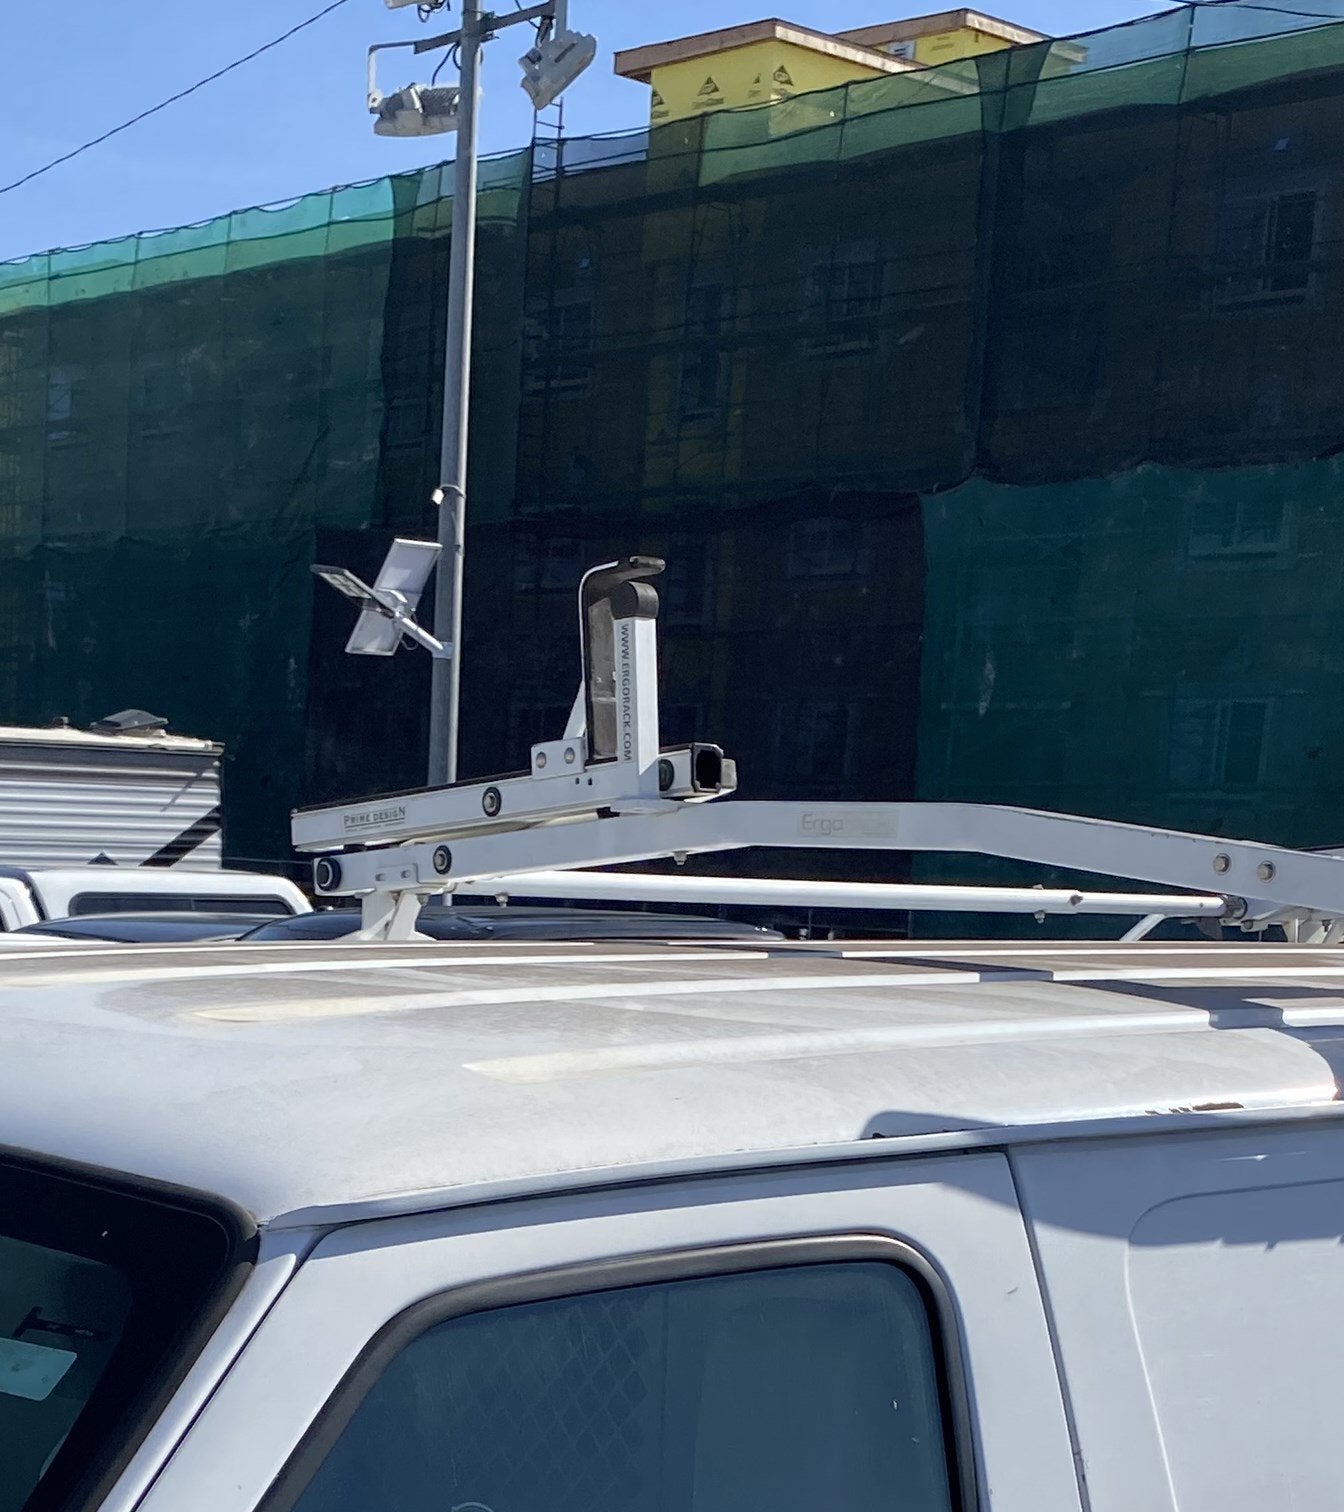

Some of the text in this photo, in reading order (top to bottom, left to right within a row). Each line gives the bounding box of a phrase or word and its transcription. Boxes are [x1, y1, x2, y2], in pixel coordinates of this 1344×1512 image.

[620, 624, 633, 762] WWW.ERGORACK.COM
[343, 806, 406, 826] PRIME DESIGN
